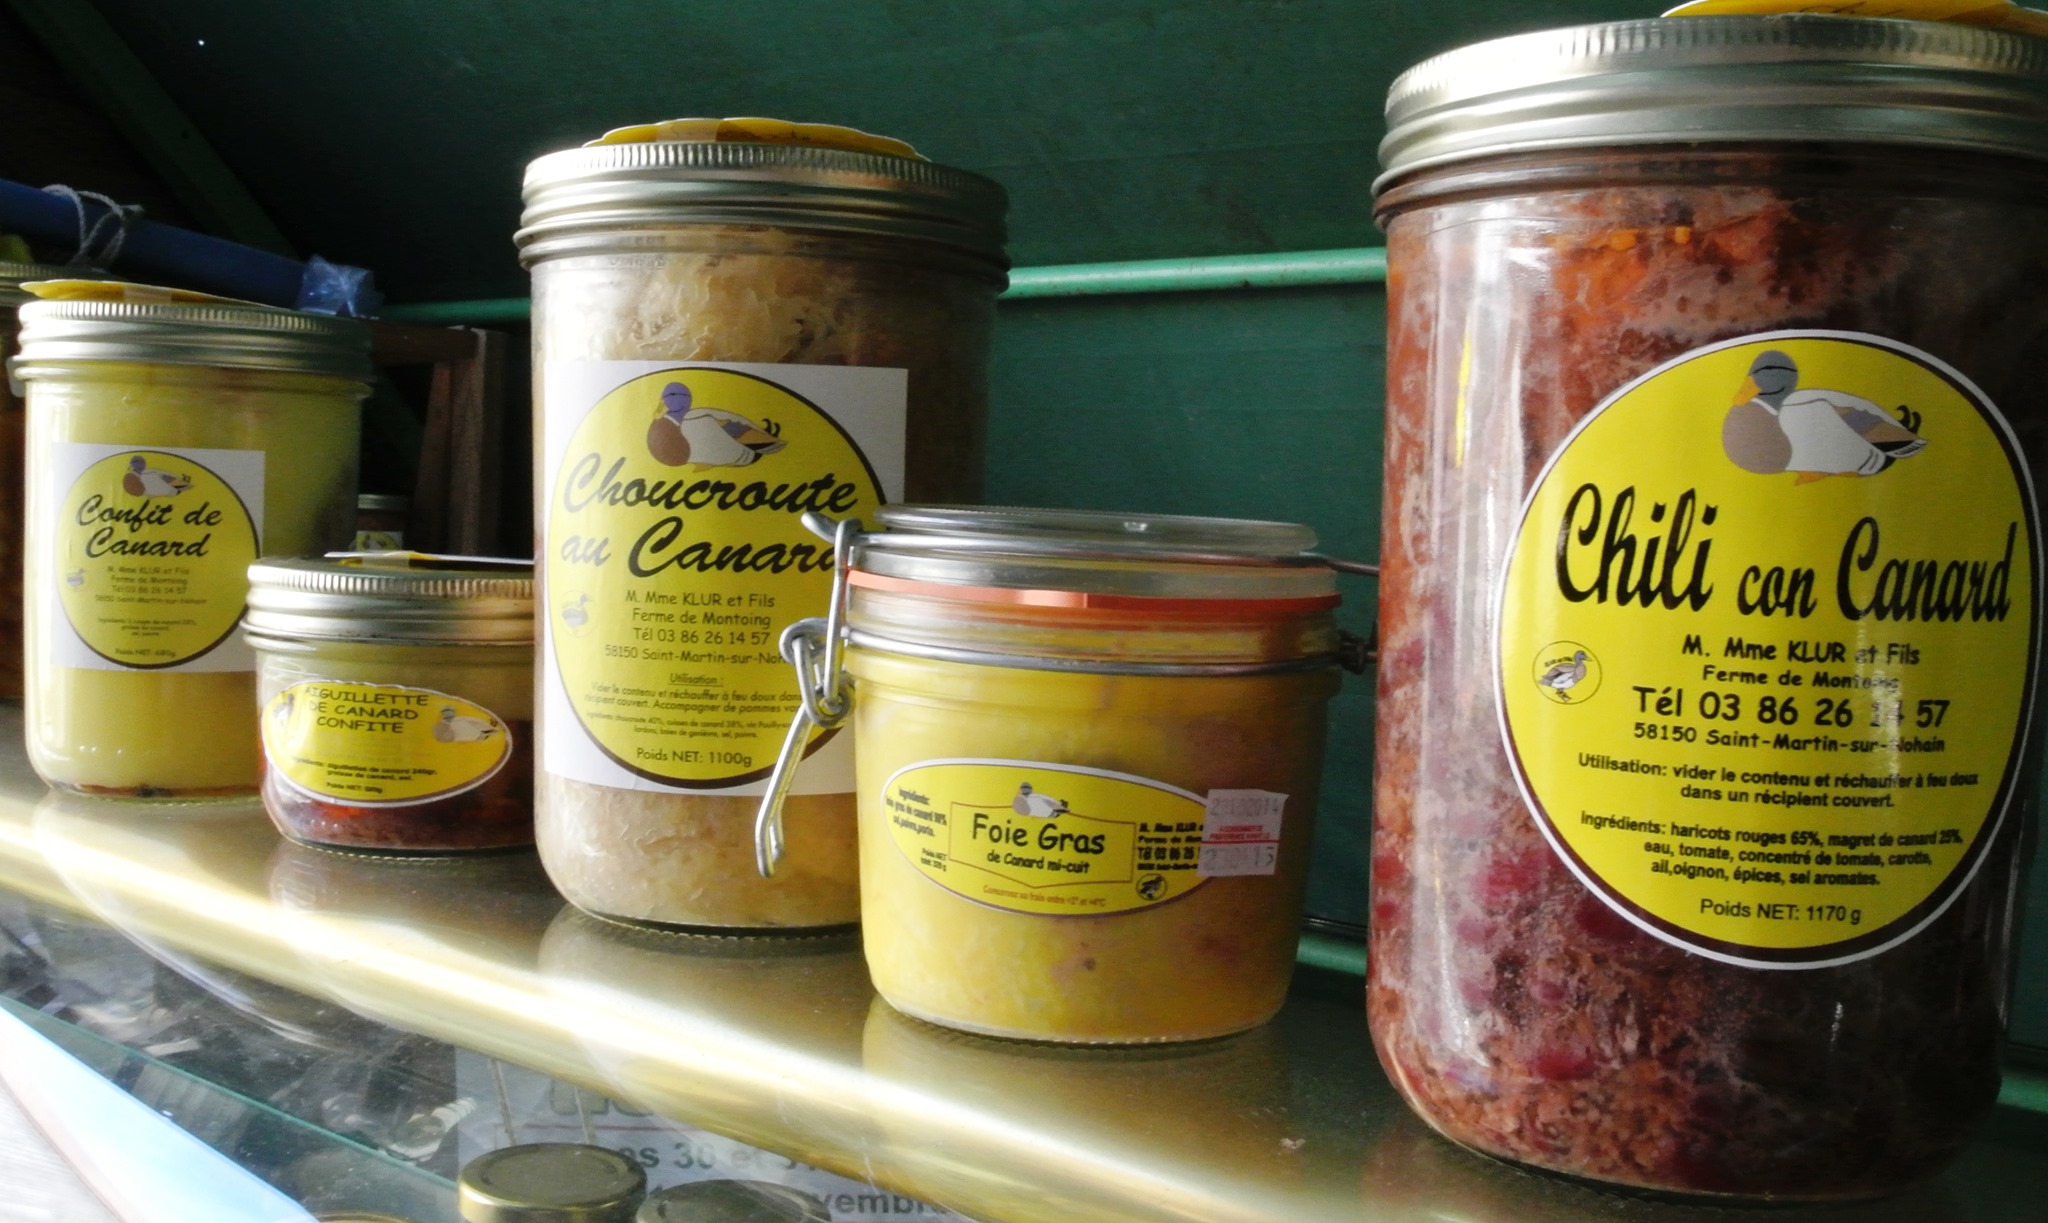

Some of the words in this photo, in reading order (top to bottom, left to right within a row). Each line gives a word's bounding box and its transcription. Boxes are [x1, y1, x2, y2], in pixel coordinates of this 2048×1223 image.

[563, 453, 858, 513] Choucroute
[77, 494, 173, 533] Confit
[184, 501, 222, 526] de
[85, 526, 211, 558] Canard
[561, 535, 612, 565] au
[1555, 483, 1718, 612] Chili
[1738, 565, 1817, 619] con
[1837, 516, 2018, 622] Canard
[645, 591, 677, 605] Mme
[682, 592, 722, 607] KLUR
[727, 595, 743, 607] et
[748, 594, 775, 607] Fils
[632, 608, 674, 623] Ferme
[679, 609, 697, 624] de
[702, 612, 771, 630] Montoing
[633, 627, 653, 641] Tél
[657, 629, 675, 642] 03
[681, 630, 699, 644] 86
[705, 631, 723, 645] 26
[729, 632, 746, 645] 14
[751, 632, 770, 646] 57
[1682, 634, 1711, 657] M.
[1724, 637, 1777, 660] Mme
[1788, 640, 1846, 663] KLUR
[1855, 645, 1877, 664] et
[1887, 643, 1920, 665] Fils
[1703, 664, 1768, 684] Ferme
[1778, 670, 1802, 686] de
[305, 687, 429, 706] AIGUILLETTE
[669, 688, 719, 700] réchauffer
[732, 690, 747, 701] feu
[750, 690, 776, 701] doux
[334, 704, 418, 720] CANARD
[653, 700, 720, 714] Accompagner
[723, 702, 736, 712] de
[739, 705, 780, 715] pommes
[1633, 686, 1683, 717] Tél
[1699, 691, 1740, 721] 03
[1758, 696, 1798, 725] 86
[1814, 698, 1853, 727] 26
[1917, 700, 1950, 728] 57
[316, 716, 404, 734] CONFITE
[1634, 722, 1697, 743] 58150
[637, 747, 668, 760] Poids
[672, 750, 703, 763] NET:
[709, 751, 752, 768] 1100g
[1578, 752, 1667, 776] Utilisation:
[1673, 765, 1716, 780] vider
[1721, 767, 1736, 782] le
[1741, 771, 1810, 786] contenu
[1815, 773, 1830, 788] et
[1915, 773, 1923, 788] à
[1927, 773, 1947, 787] feu
[1950, 773, 1979, 787] doux
[1680, 784, 1722, 800] dans
[1728, 791, 1748, 803] un
[1755, 789, 1828, 808] récipient
[1832, 793, 1895, 807] couvert.
[972, 813, 1028, 847] Foie
[1038, 823, 1105, 855] Gras
[1581, 811, 1666, 835] Ingrédients:
[1670, 822, 1730, 841] haricots
[1735, 830, 1786, 846] rouges
[1790, 831, 1823, 847] 65%,
[1828, 833, 1875, 849] magret
[1879, 833, 1893, 846] de
[1897, 831, 1937, 846] canard
[987, 850, 1000, 863] de
[1003, 852, 1045, 869] Canard
[1047, 859, 1090, 874] mi-cuit
[1644, 841, 1675, 857] eau,
[1679, 843, 1734, 862] tomate,
[1738, 849, 1811, 865] concentré
[1815, 851, 1832, 865] de
[1836, 852, 1885, 867] tomate,
[1733, 865, 1785, 885] épices,
[1789, 870, 1810, 885] sel
[1814, 871, 1880, 886] aromates.
[1700, 898, 1751, 918] Poids
[1757, 903, 1800, 920] NET:
[1806, 905, 1847, 921] 1170
[1850, 909, 1861, 926] g
[673, 1142, 716, 1170] 30
